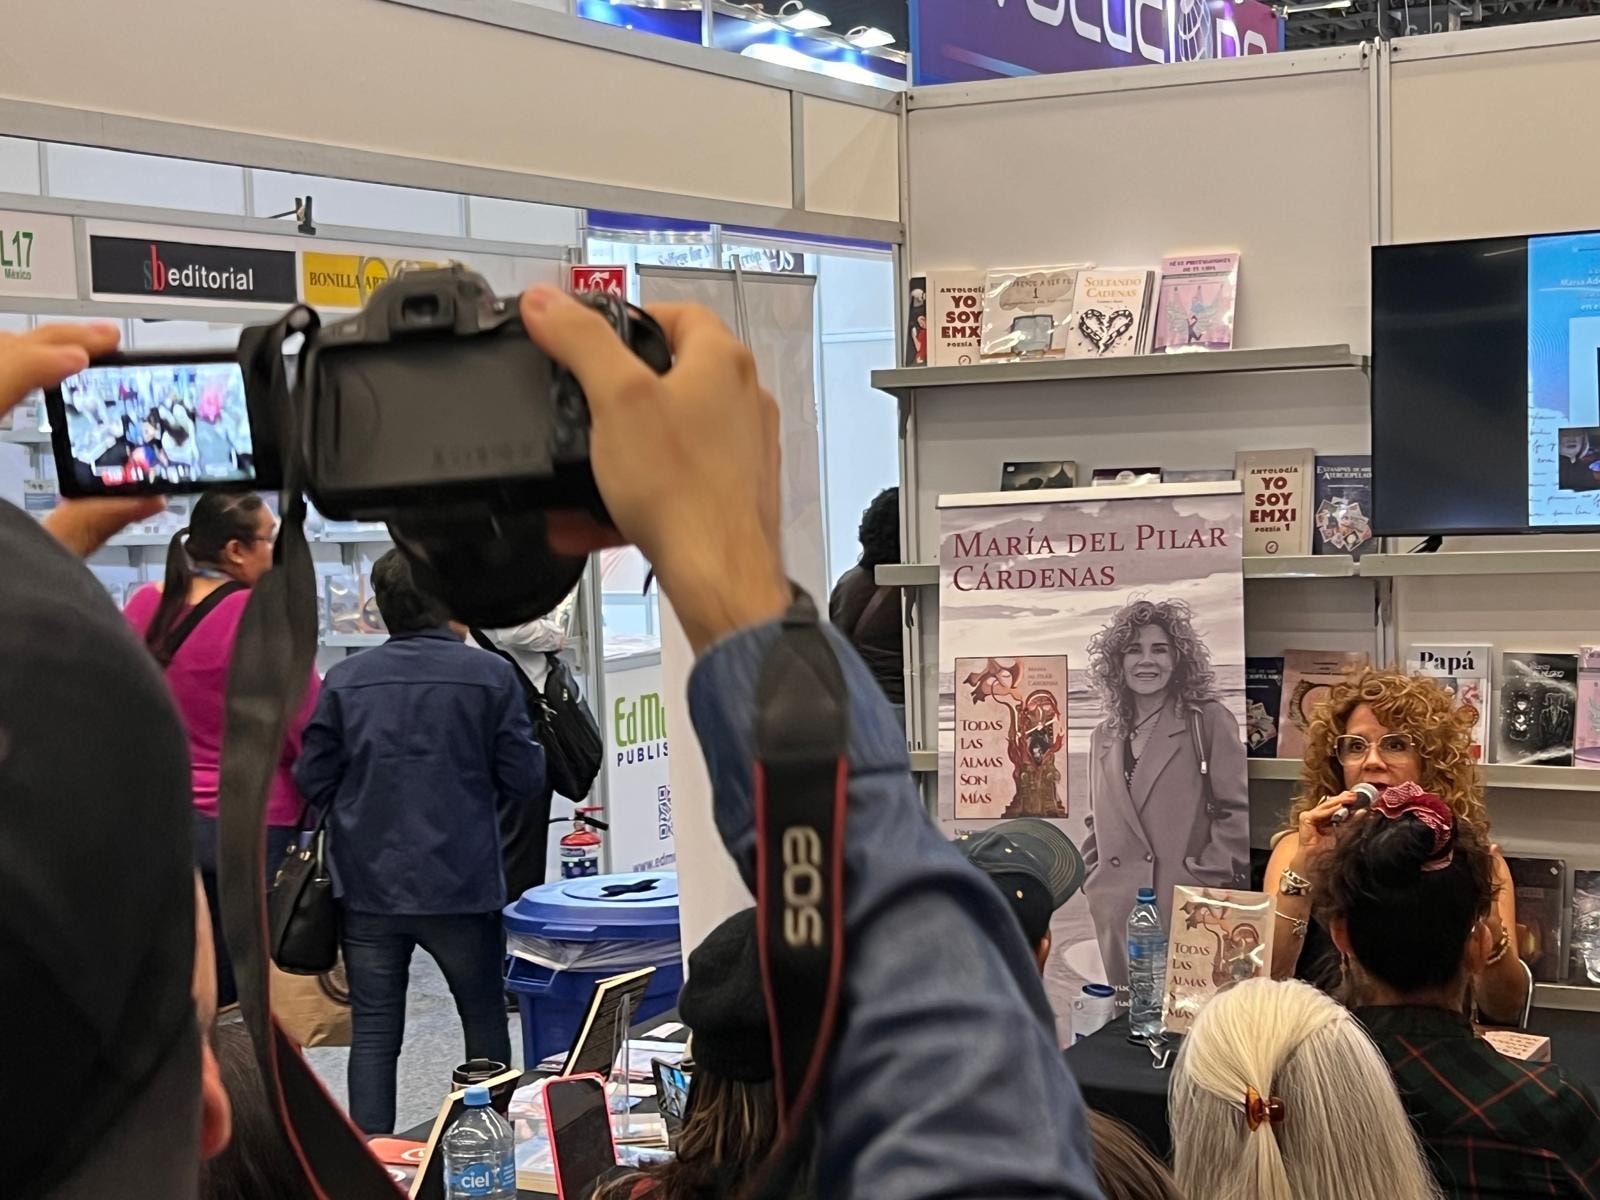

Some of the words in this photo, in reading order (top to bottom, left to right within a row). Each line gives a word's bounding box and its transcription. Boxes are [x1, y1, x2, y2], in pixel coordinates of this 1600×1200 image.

[309, 272, 360, 289] BONILLA
[1084, 277, 1142, 287] SOLTANDO
[1086, 288, 1137, 298] CADENAS
[951, 295, 977, 309] YO
[945, 311, 983, 323] SOY
[941, 326, 981, 338] EMX
[1250, 467, 1299, 475] ANTOLOGÍA
[1261, 477, 1287, 490] YO
[1255, 492, 1293, 506] SOY
[1250, 508, 1297, 523] EMXI
[1285, 523, 1290, 531] 1
[953, 528, 1055, 558] MARÍA
[1067, 532, 1124, 553] DEL
[1136, 525, 1228, 550] PILAR
[953, 563, 1115, 592] CÁRDENAS
[1420, 650, 1475, 675] Papá
[960, 720, 1003, 731] TODAS
[961, 738, 983, 749] LAS
[960, 757, 1003, 768] ALMAS
[960, 774, 988, 785] SON
[960, 790, 992, 804] MÍAS
[782, 826, 823, 947] EOS
[1174, 942, 1210, 956] TODAS
[1172, 959, 1192, 970] LAS
[1170, 976, 1207, 987] ALMAS
[461, 1171, 490, 1188] ciel
